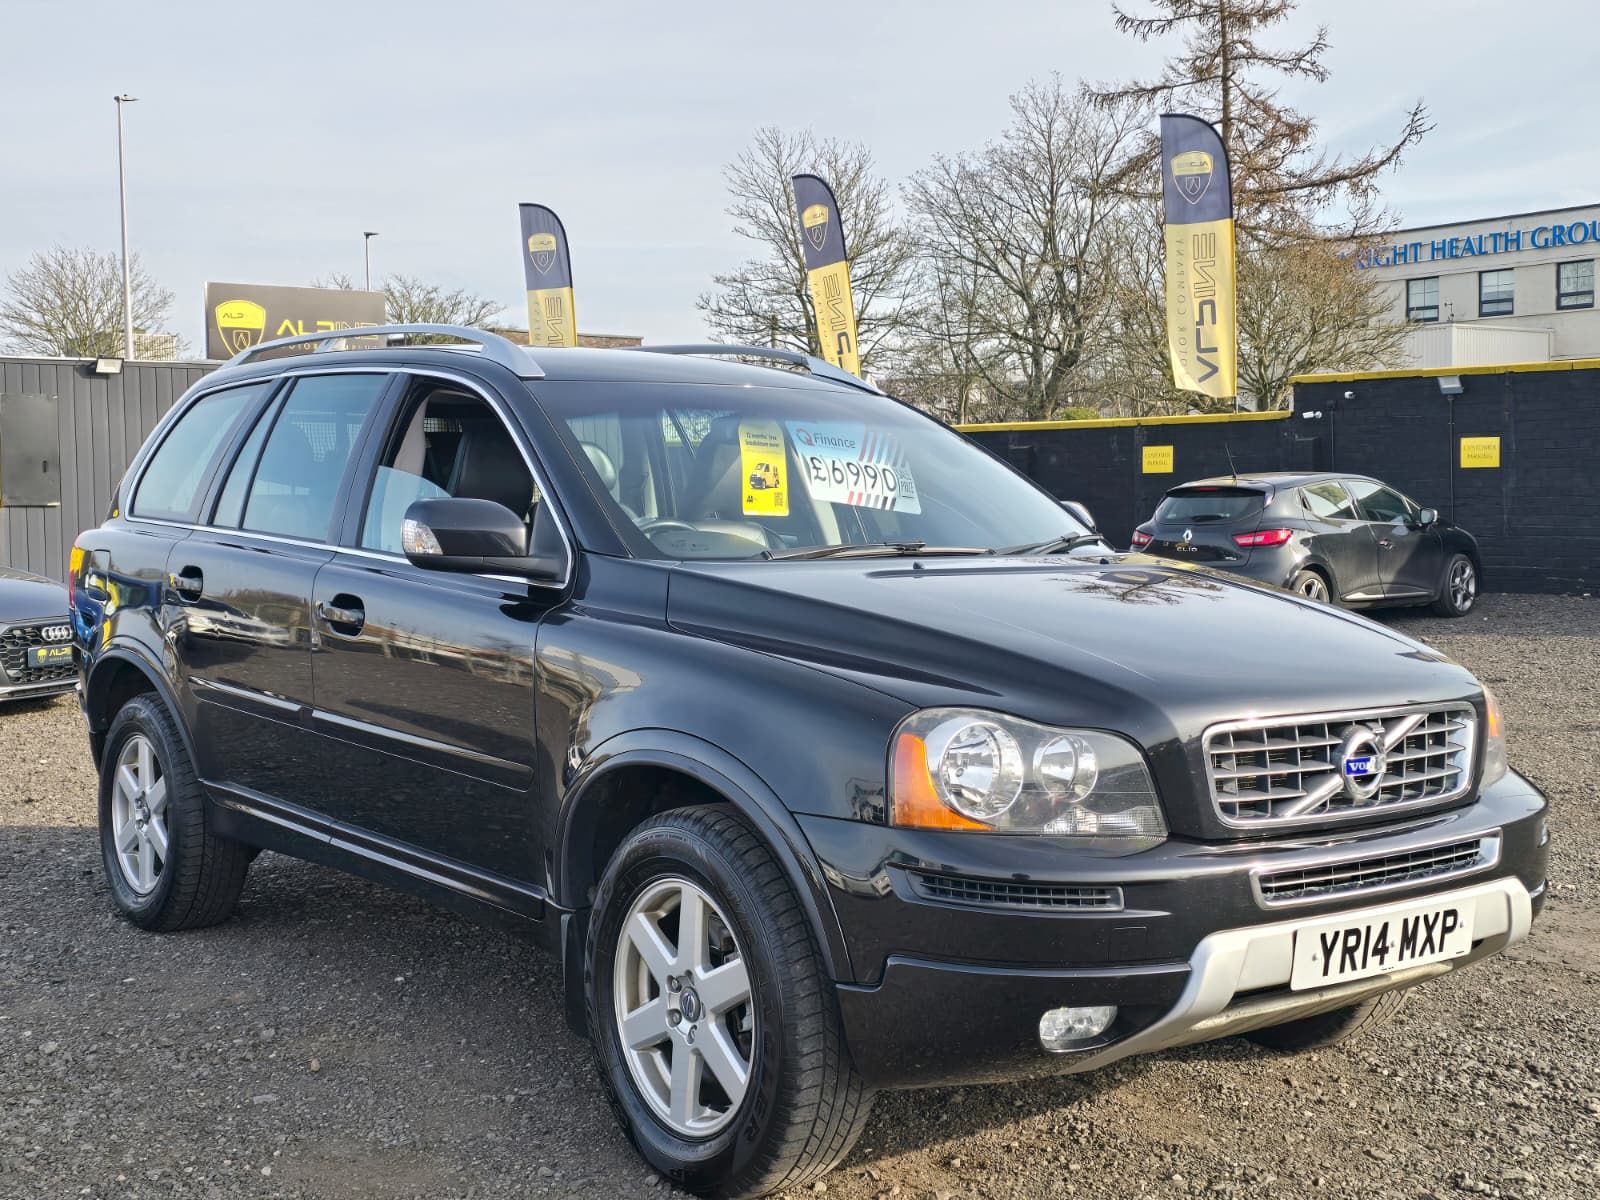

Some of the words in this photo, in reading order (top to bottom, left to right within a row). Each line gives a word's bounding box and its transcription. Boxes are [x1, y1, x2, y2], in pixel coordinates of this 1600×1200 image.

[1431, 230, 1521, 261] HEALTH
[814, 432, 857, 449] Finance
[809, 456, 898, 492] £6990
[1319, 921, 1390, 977] YR14
[1397, 908, 1459, 962] MXP
